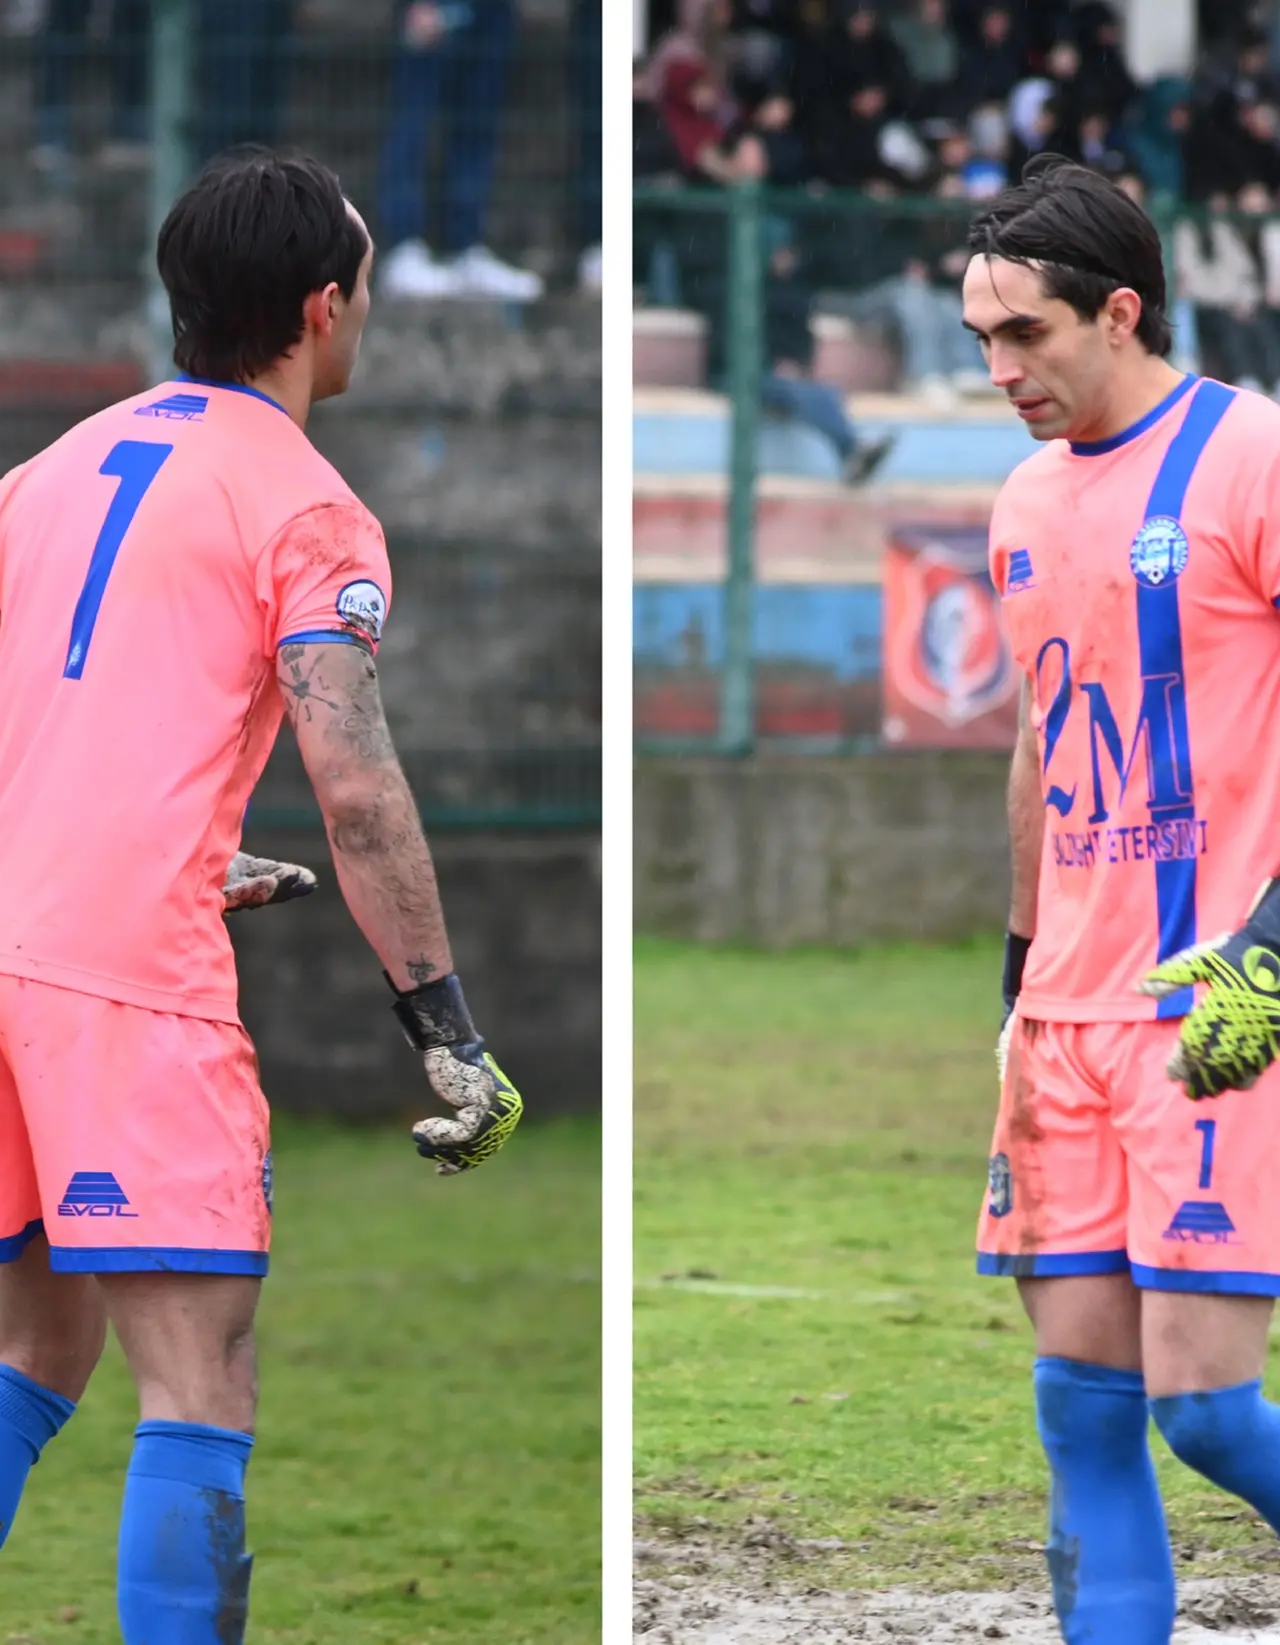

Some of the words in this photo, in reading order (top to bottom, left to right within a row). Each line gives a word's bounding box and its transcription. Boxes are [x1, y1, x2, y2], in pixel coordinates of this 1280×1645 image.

[63, 439, 175, 681] 1
[1036, 637, 1195, 825] 2M
[57, 1203, 139, 1218] EVOL
[1194, 1119, 1216, 1189] 1
